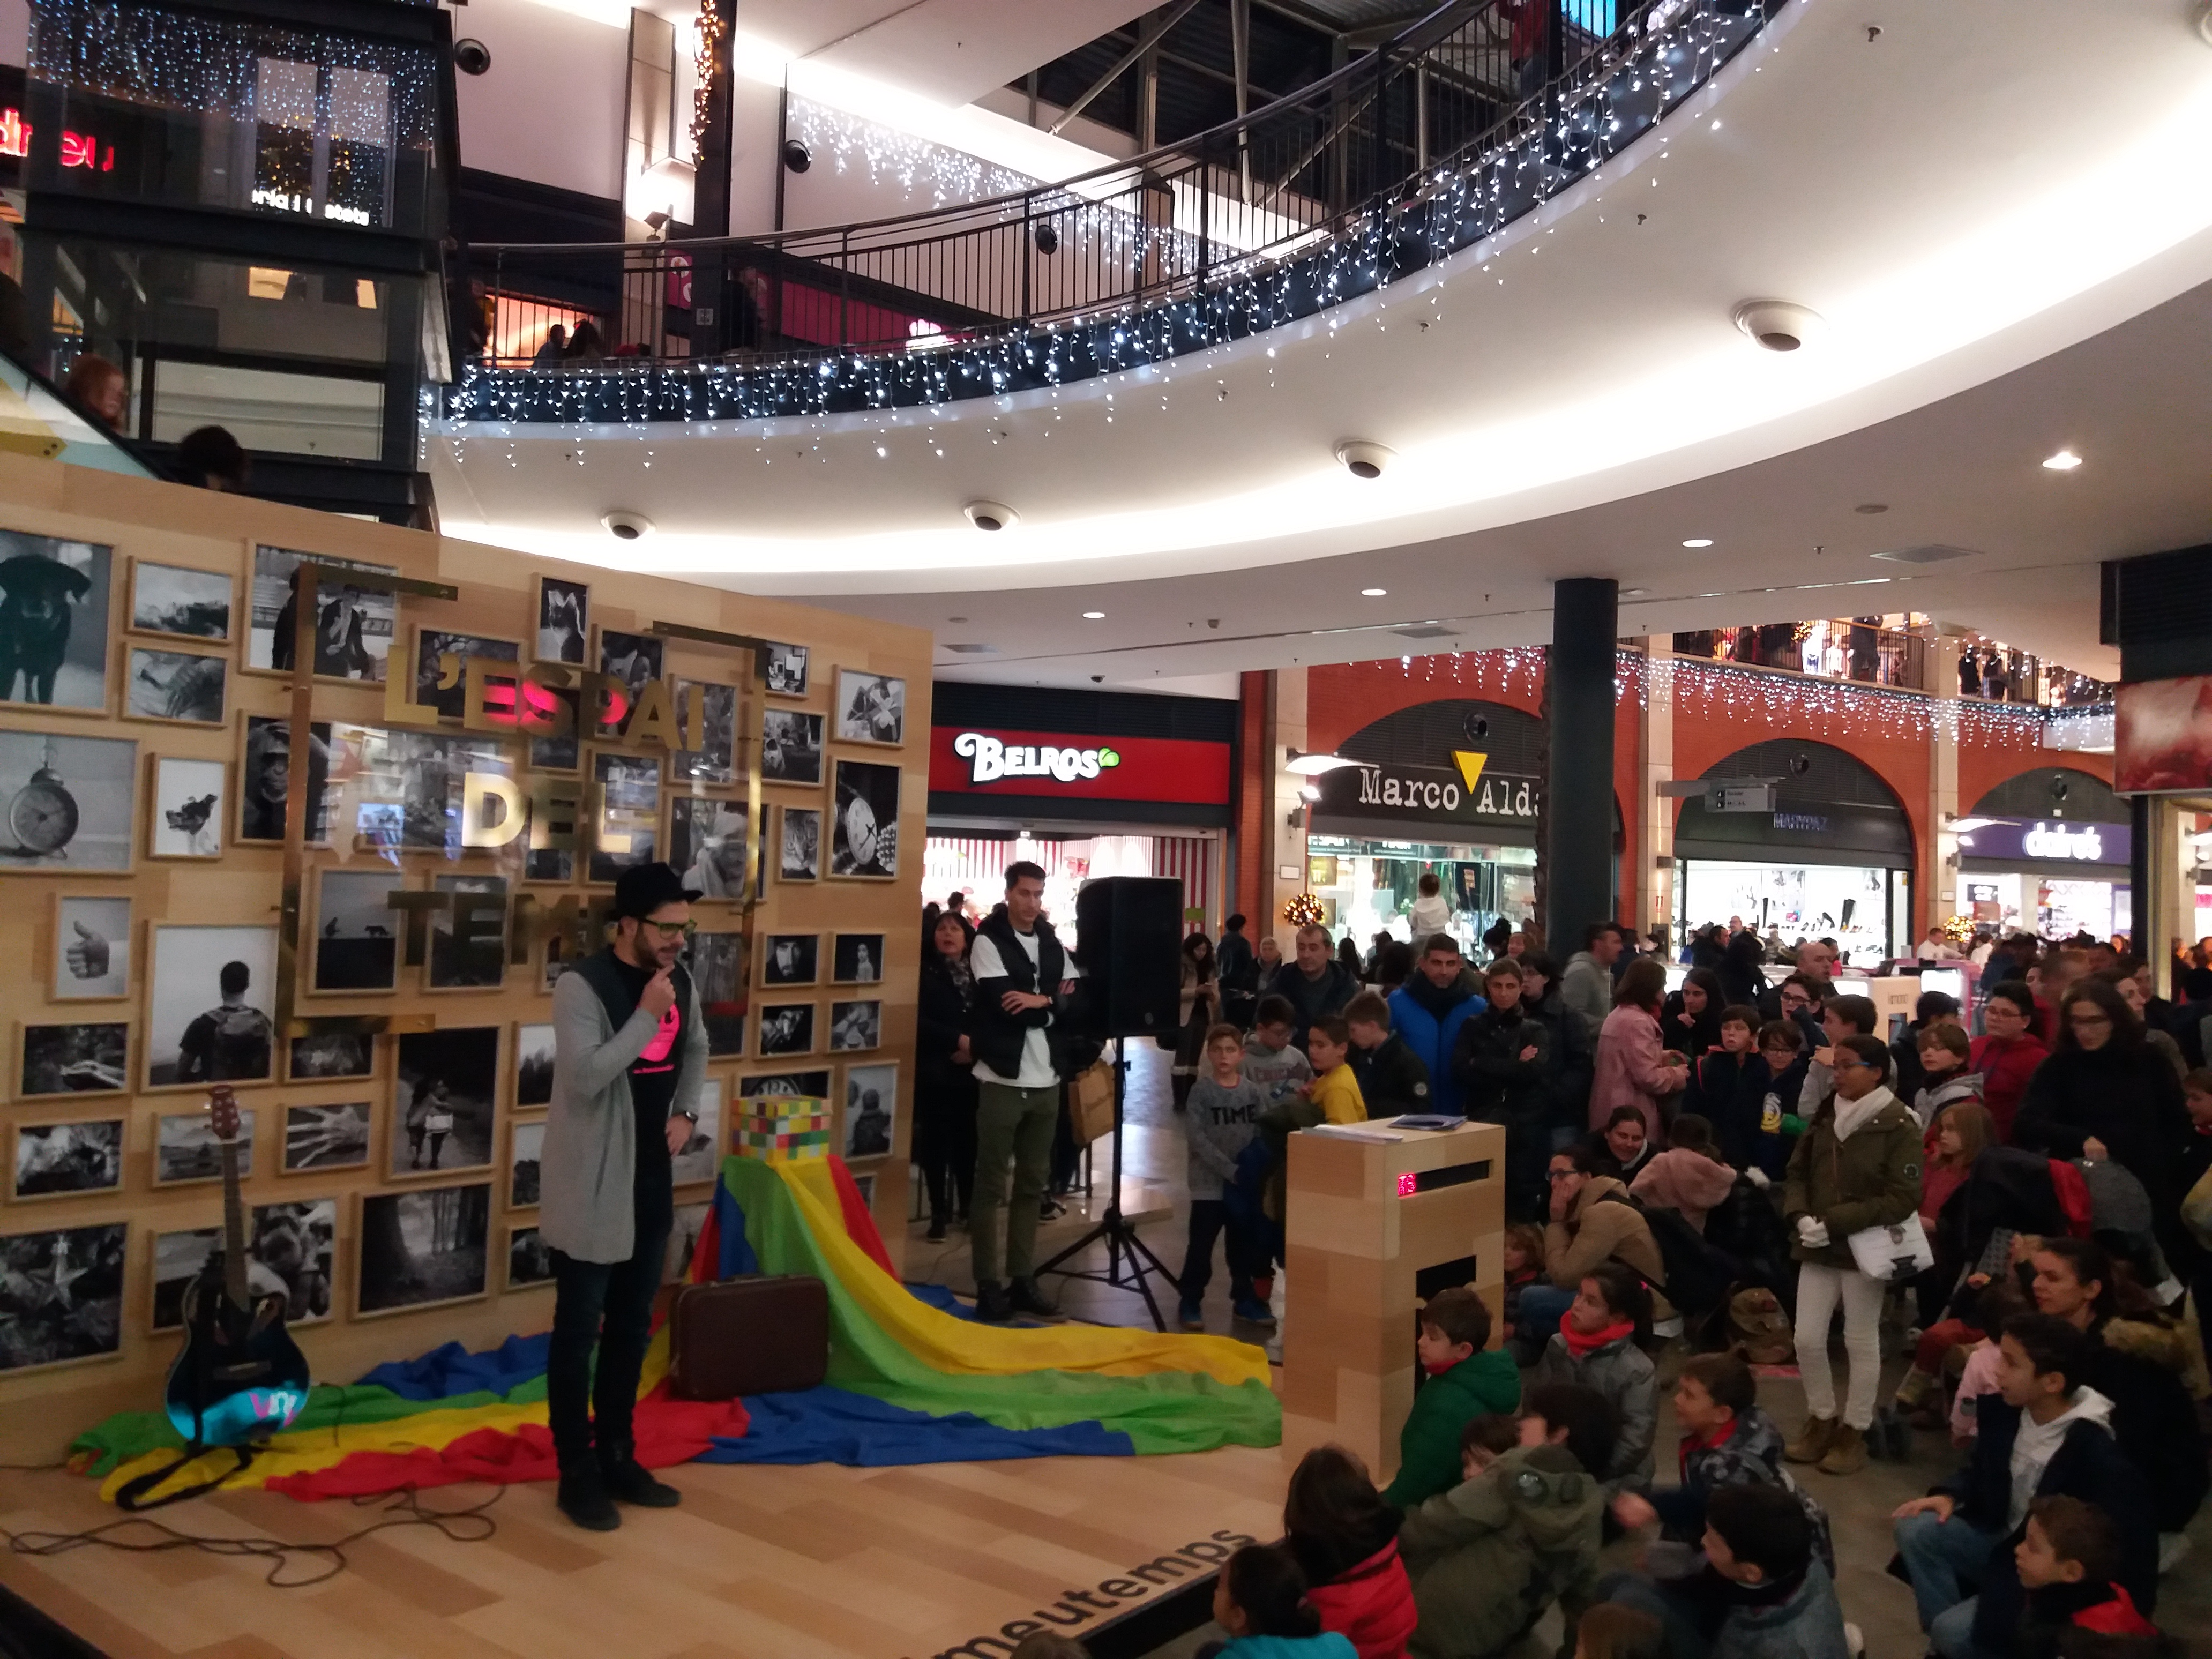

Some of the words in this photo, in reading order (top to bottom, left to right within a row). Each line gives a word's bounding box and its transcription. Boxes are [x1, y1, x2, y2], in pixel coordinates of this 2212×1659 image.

[384, 645, 704, 750] L'ESPAI
[954, 733, 1100, 782] BELROS
[461, 772, 631, 854] DEL
[1359, 768, 1460, 811] Marco
[1476, 780, 1540, 817] Ald
[1211, 1104, 1257, 1125] TIME
[900, 1529, 1257, 1659] meutemps
